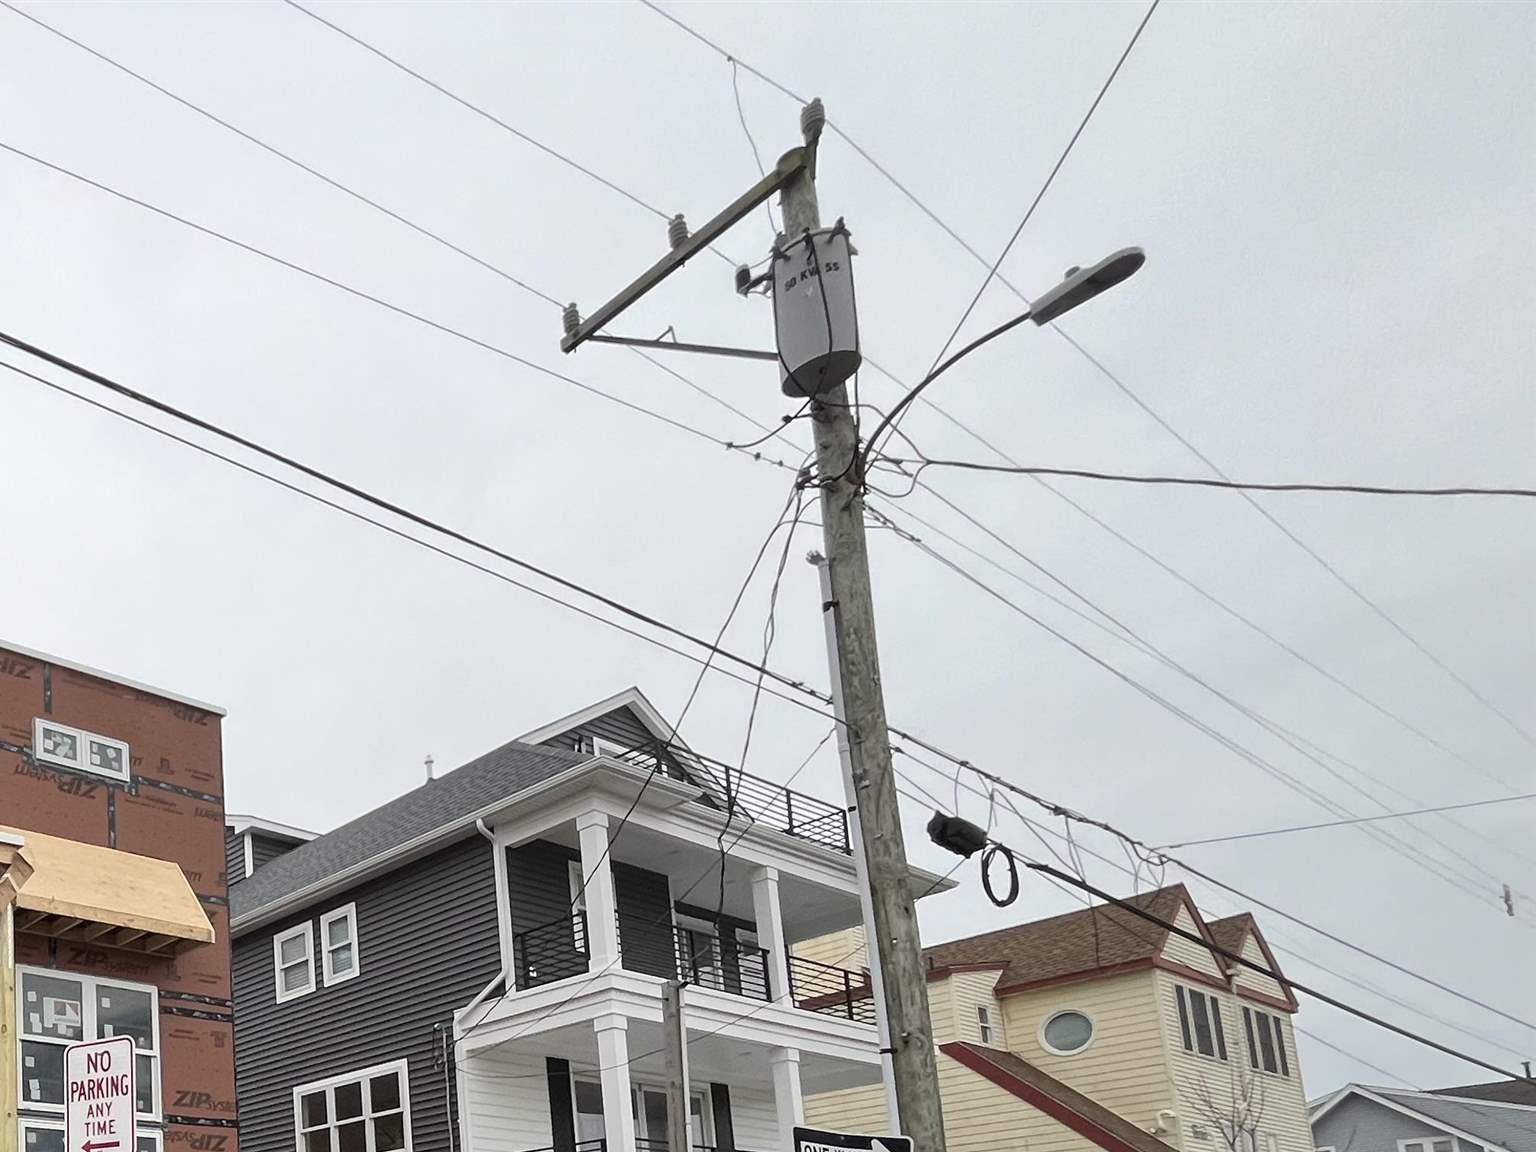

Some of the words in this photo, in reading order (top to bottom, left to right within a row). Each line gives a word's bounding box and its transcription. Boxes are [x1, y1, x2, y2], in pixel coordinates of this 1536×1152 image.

[87, 1050, 111, 1074] NO
[71, 1074, 129, 1103] PARKING
[87, 1102, 112, 1119] ANY
[84, 1120, 116, 1137] TIME
